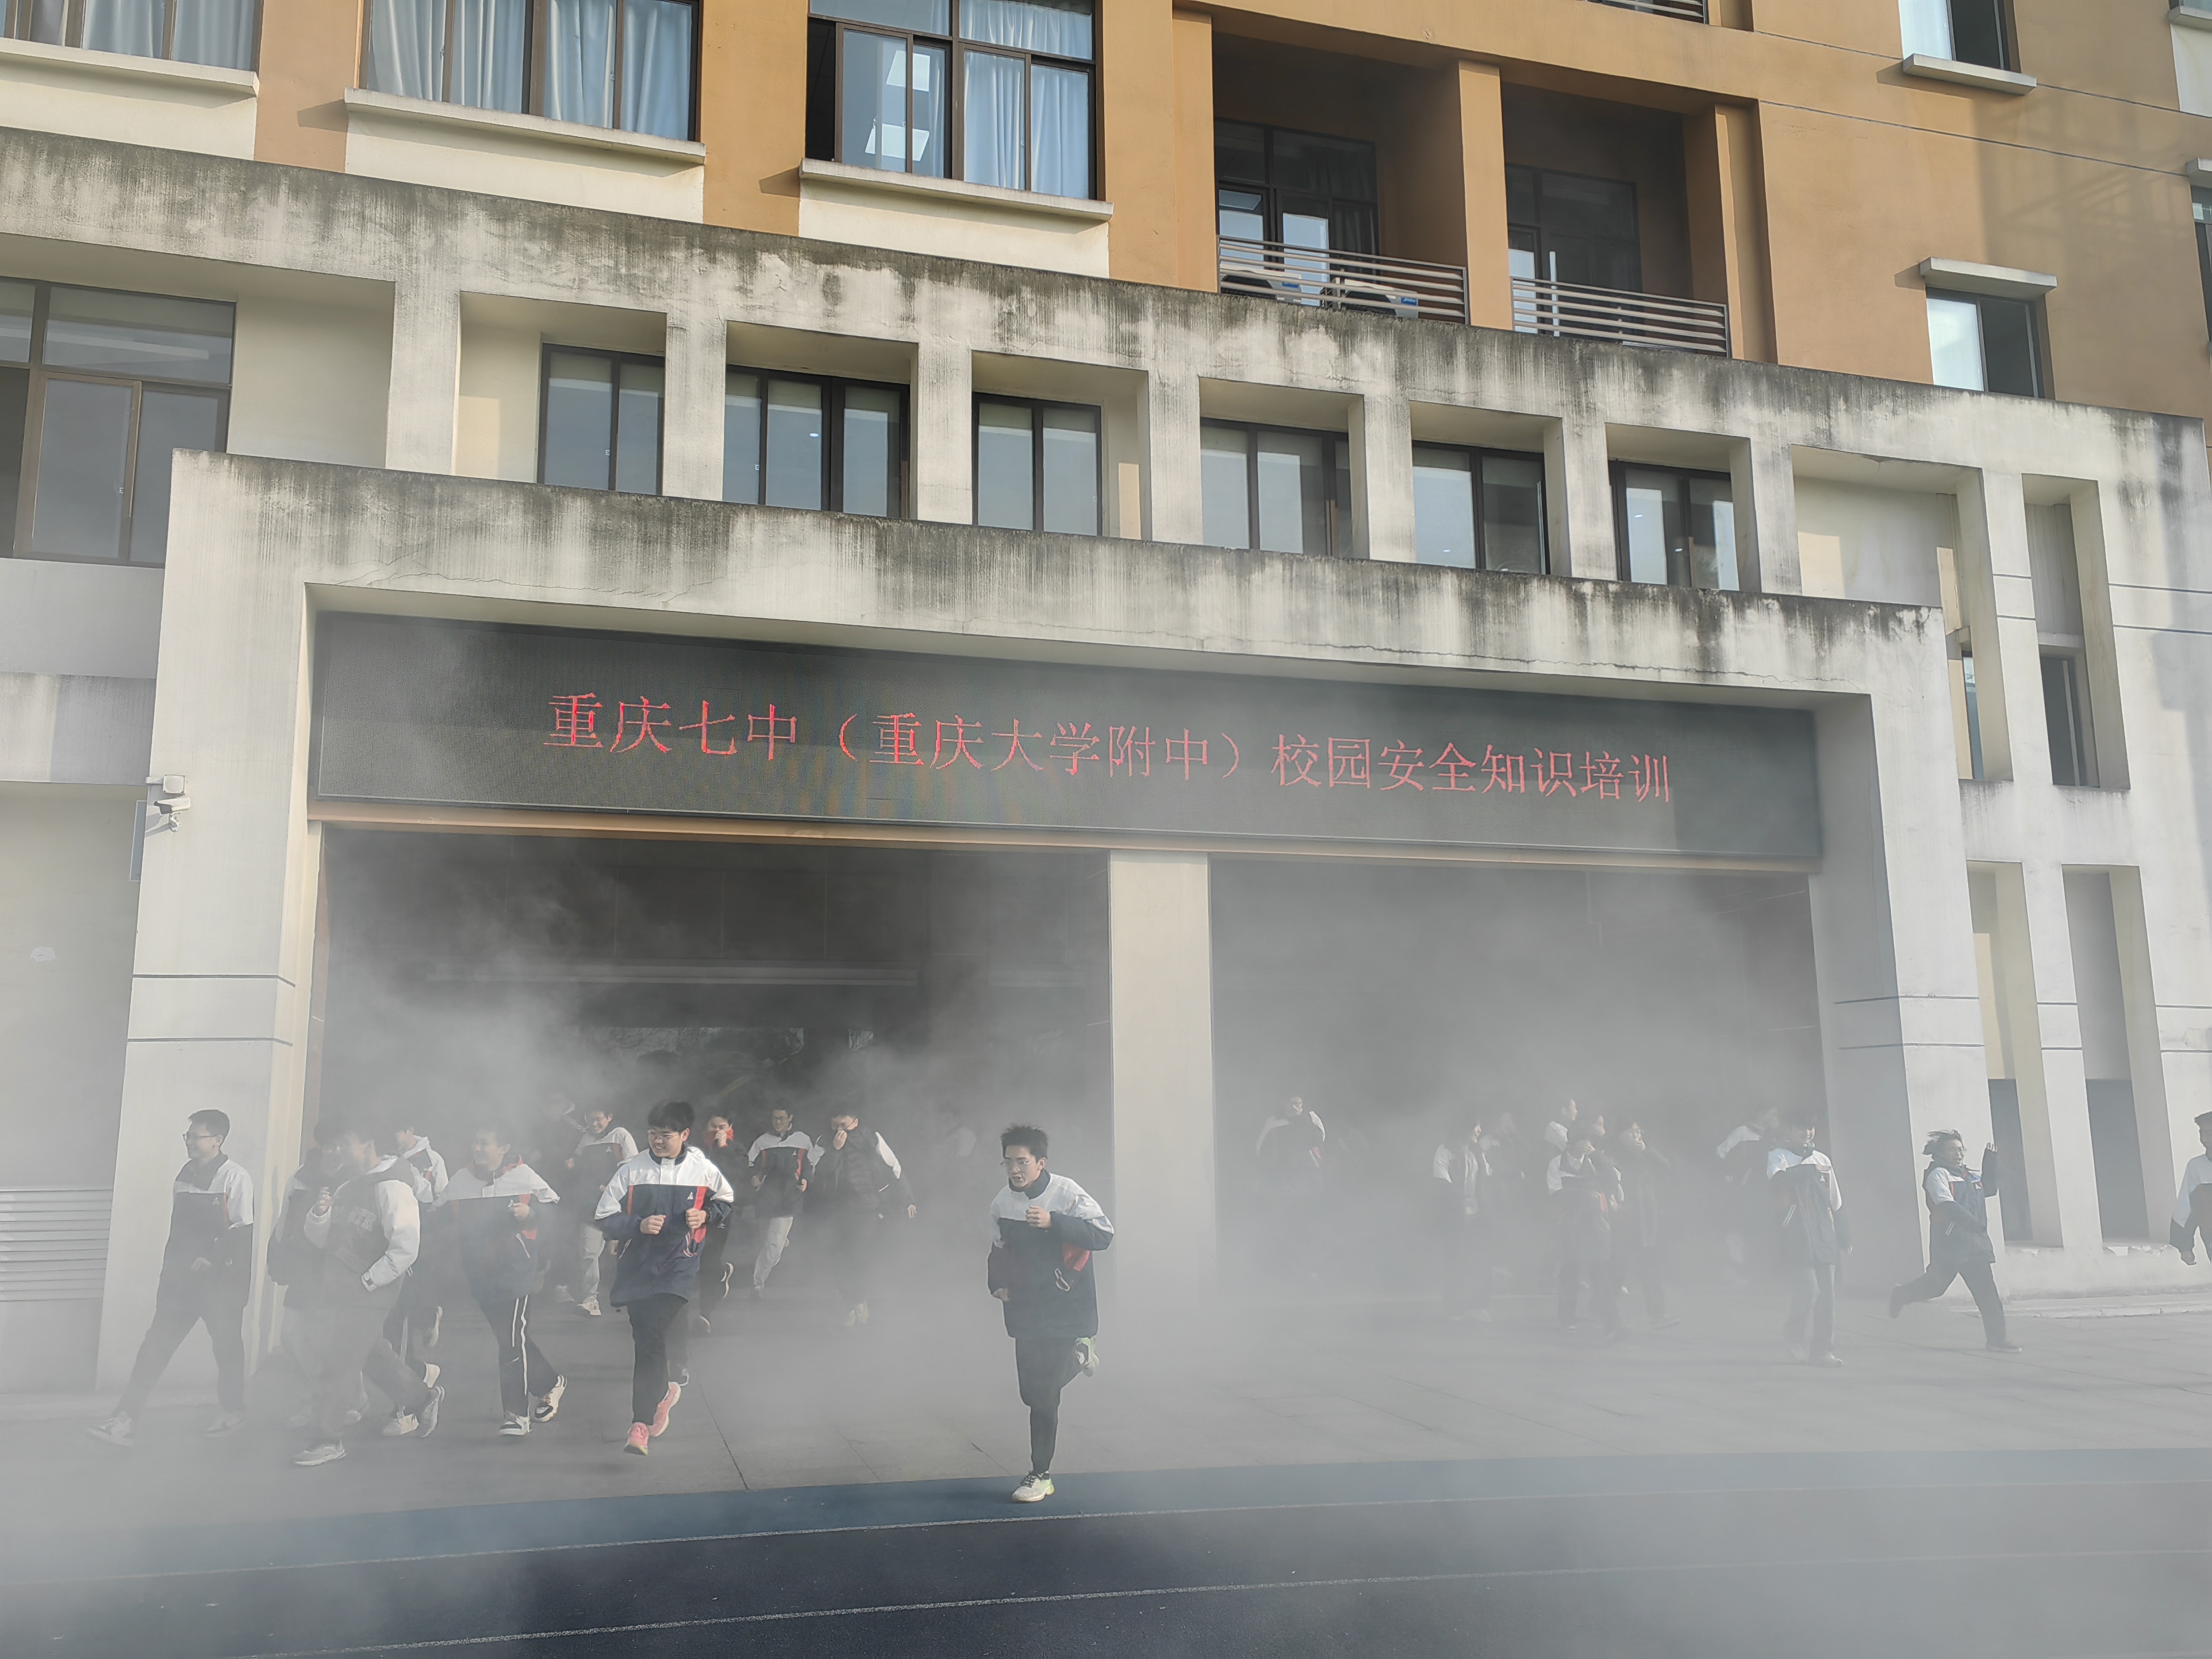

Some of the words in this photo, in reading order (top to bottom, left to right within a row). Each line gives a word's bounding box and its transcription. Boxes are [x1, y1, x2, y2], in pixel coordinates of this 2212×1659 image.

[543, 692, 1669, 802] 重庆七中（重庆大学附中）校园安全知识培训
